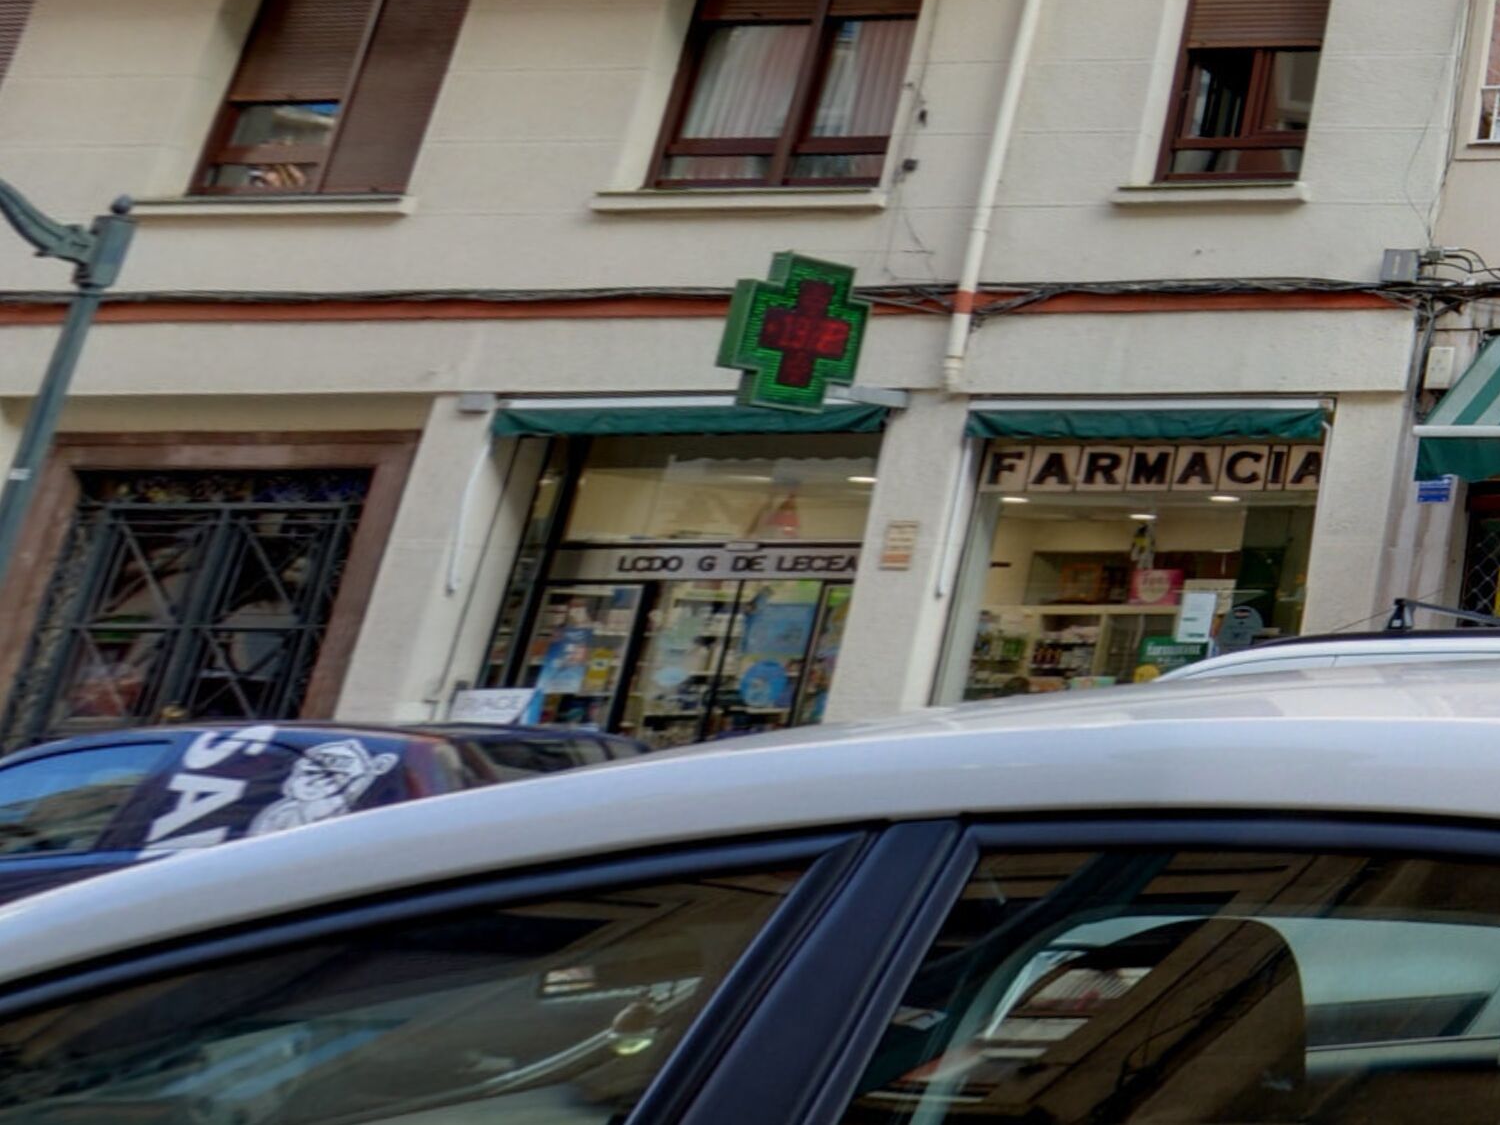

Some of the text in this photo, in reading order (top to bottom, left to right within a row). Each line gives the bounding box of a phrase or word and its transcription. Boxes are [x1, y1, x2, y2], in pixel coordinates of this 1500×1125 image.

[986, 450, 1322, 486] FARMACIA
[617, 555, 684, 572] LCDO
[696, 555, 717, 572] G
[731, 555, 767, 572] DE
